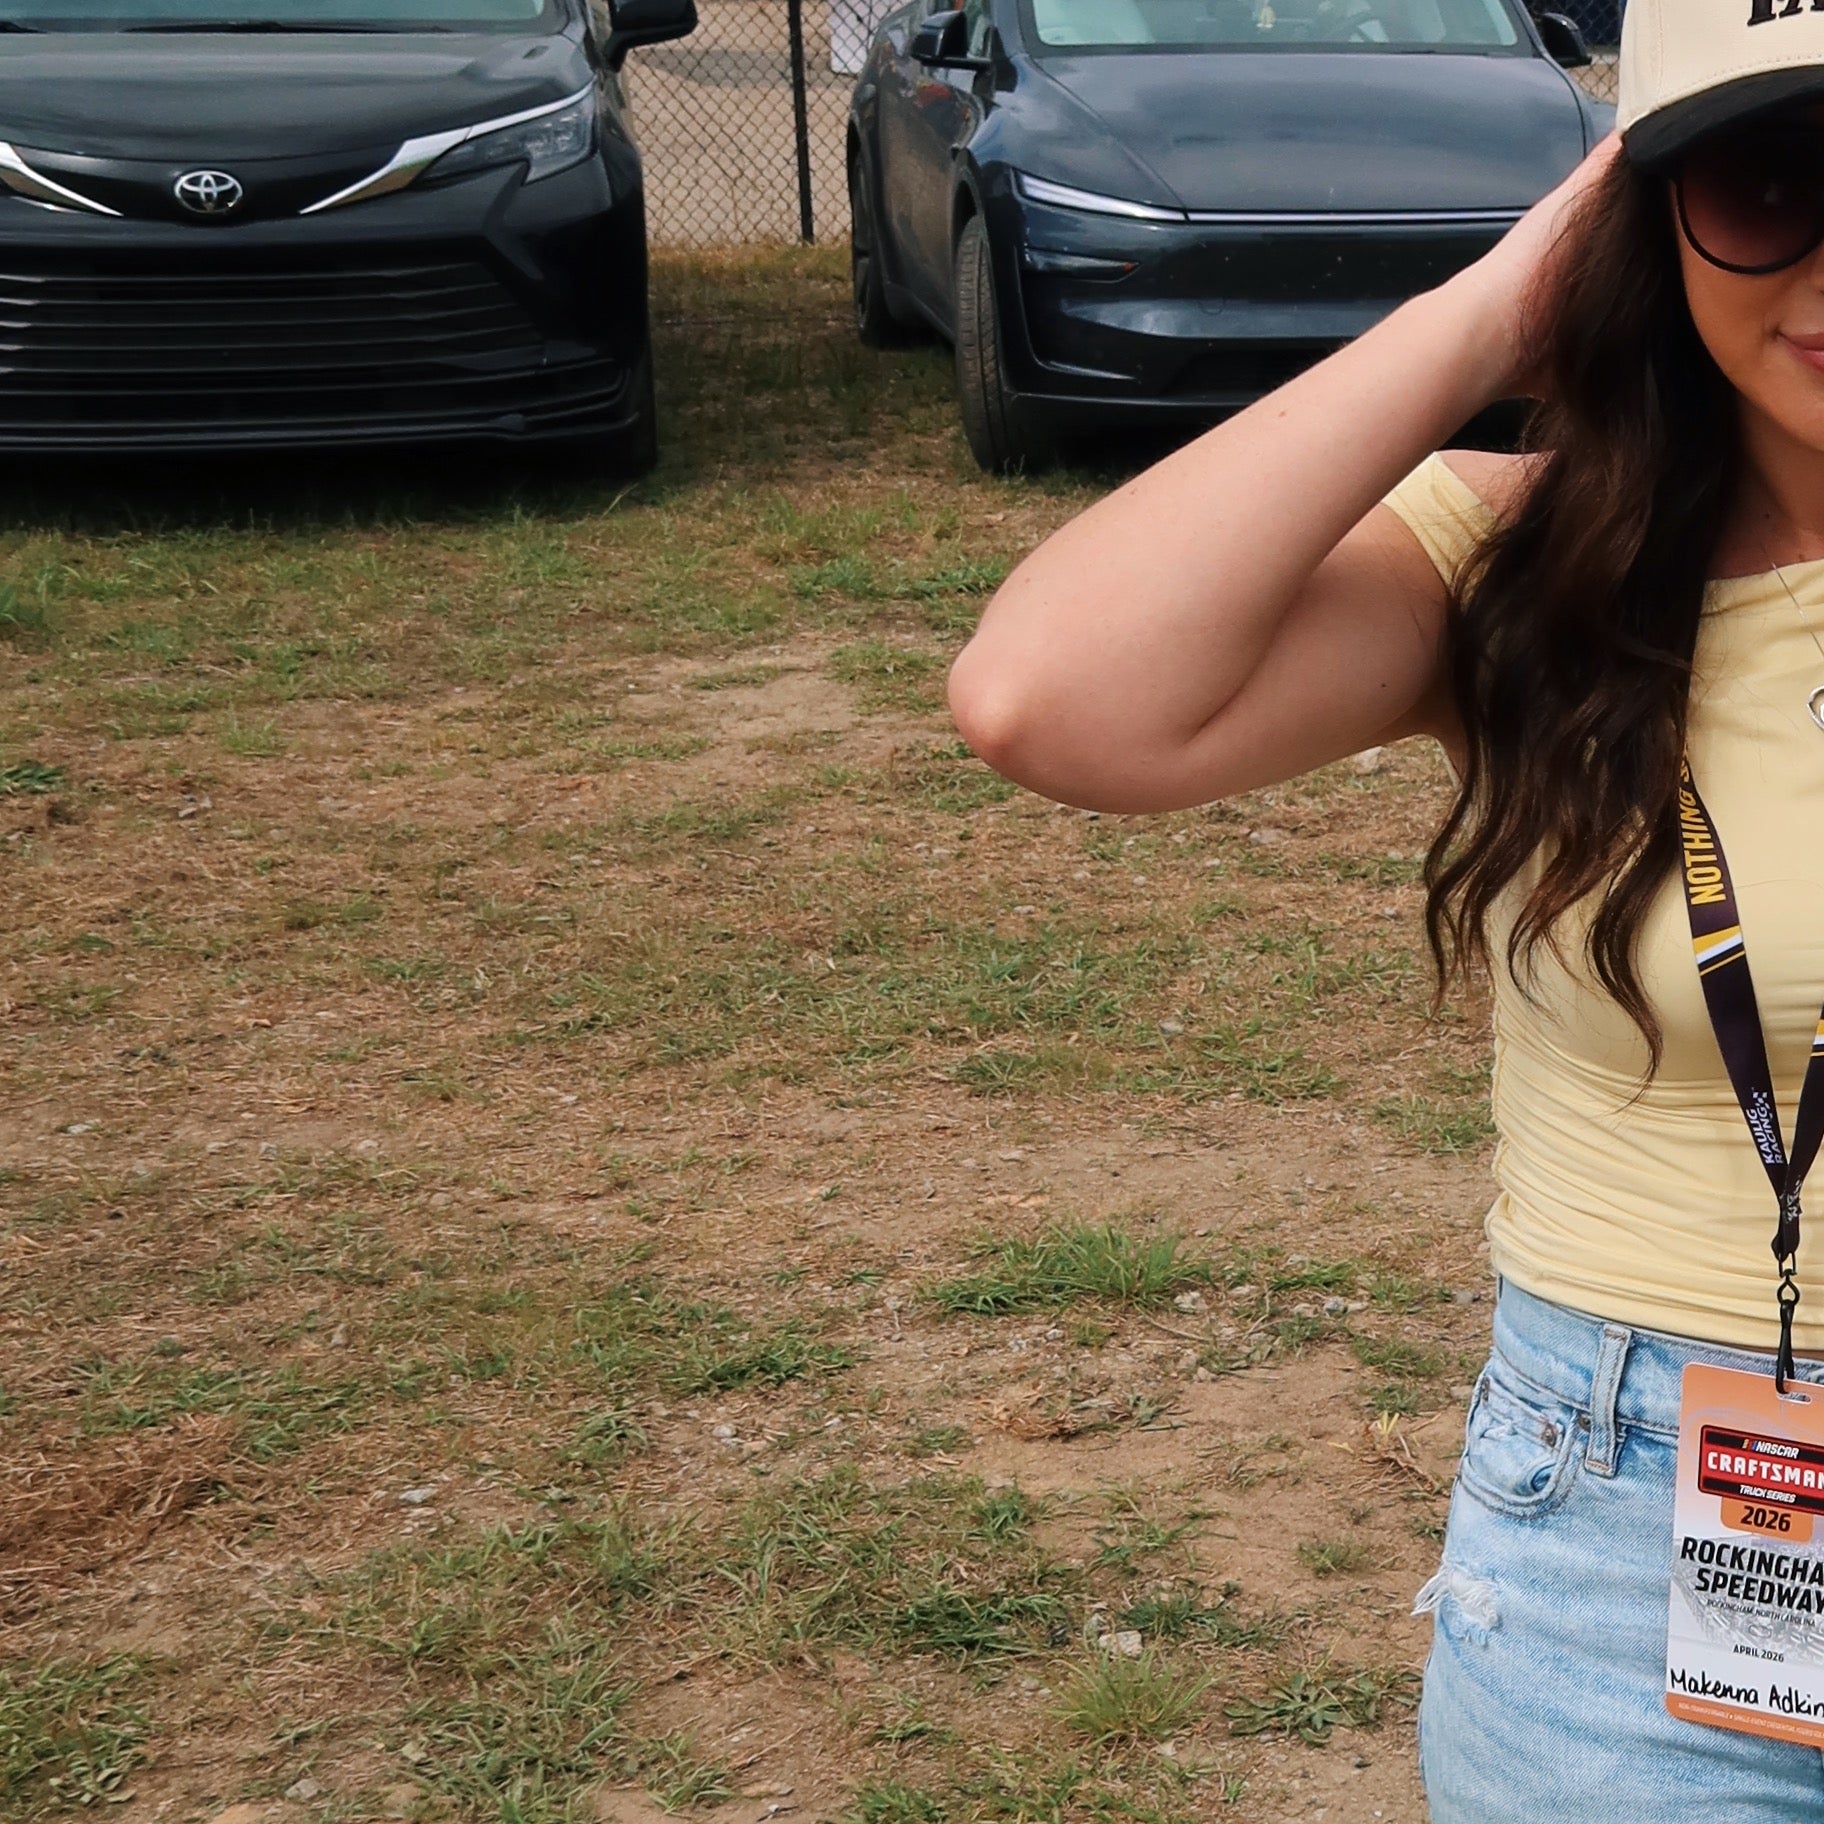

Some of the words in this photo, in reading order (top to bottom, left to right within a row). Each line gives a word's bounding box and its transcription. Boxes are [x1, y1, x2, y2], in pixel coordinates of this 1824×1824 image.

[1679, 787, 1727, 905] NOTHING
[1746, 1108, 1776, 1165] KAULIG
[1757, 1106, 1785, 1165] RACING
[1756, 1441, 1800, 1460] NASCAR
[1739, 1484, 1766, 1499] TRUCK
[1766, 1489, 1797, 1504] SERIES
[1740, 1505, 1792, 1532] 2026
[1733, 1644, 1759, 1658] APRIL
[1761, 1649, 1784, 1663] 2026
[1670, 1667, 1760, 1706] Makenna
